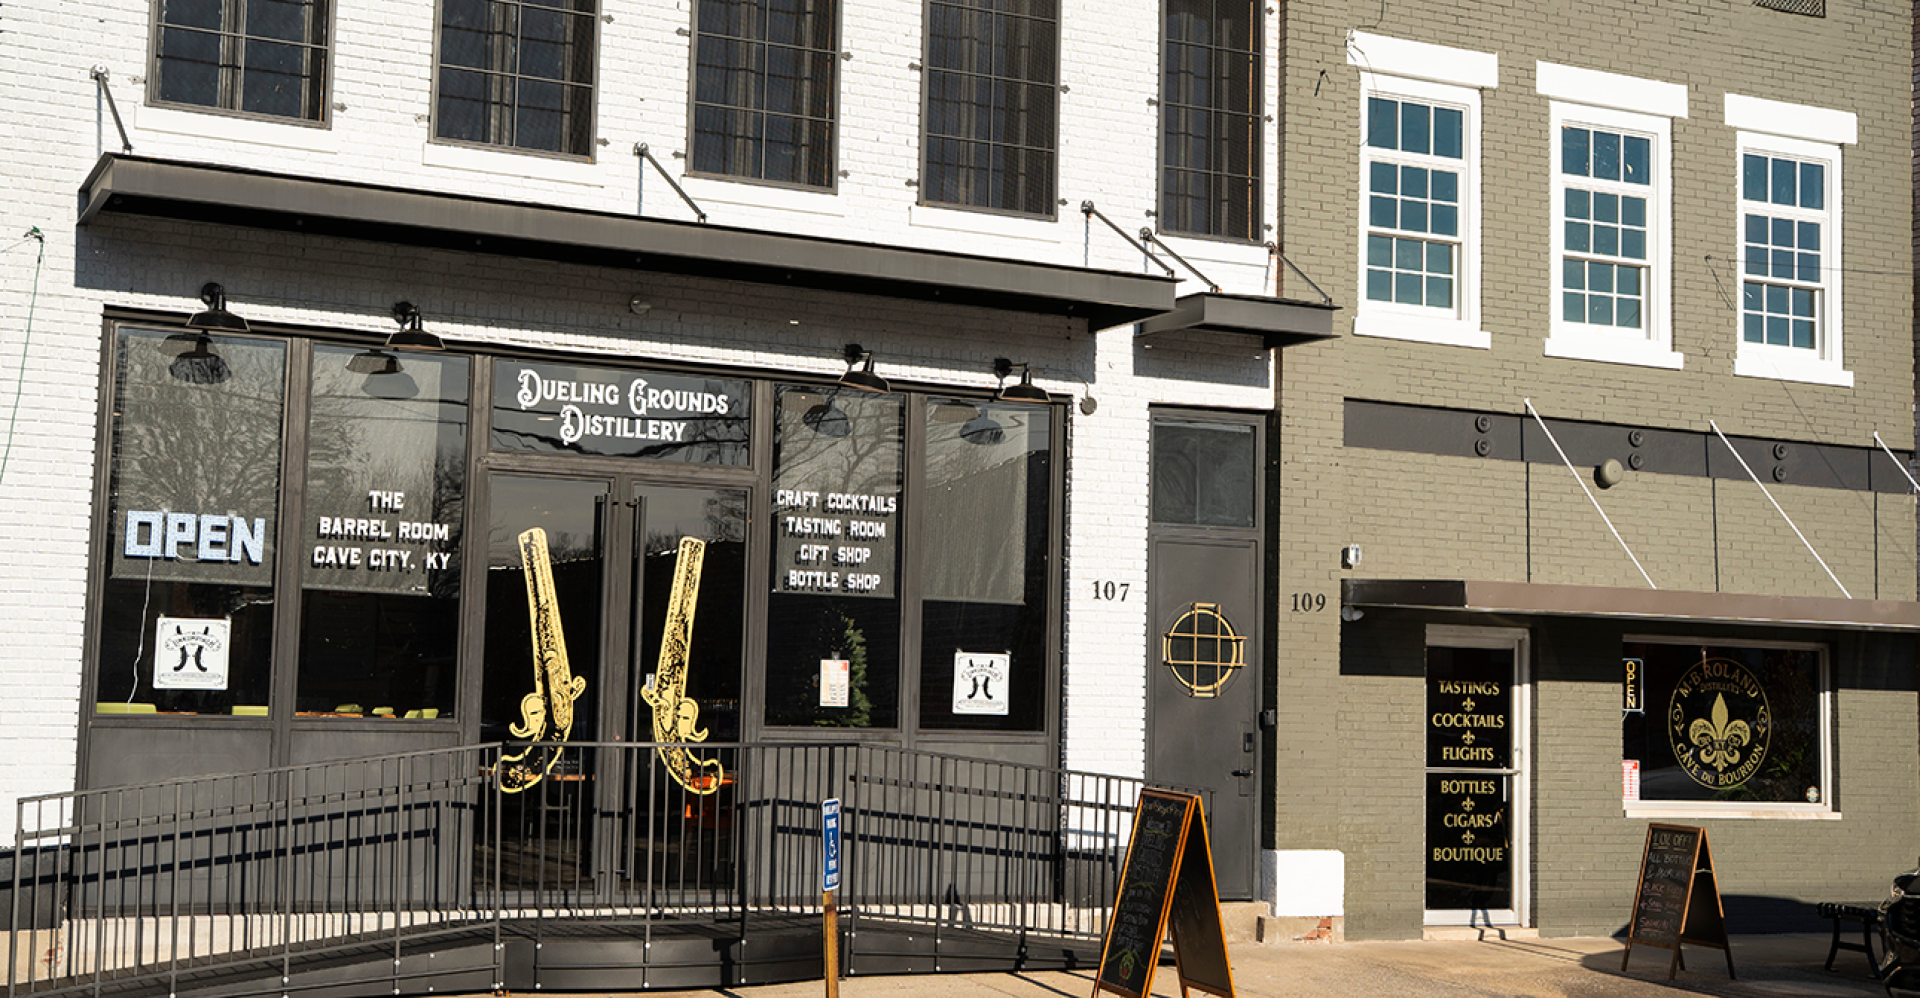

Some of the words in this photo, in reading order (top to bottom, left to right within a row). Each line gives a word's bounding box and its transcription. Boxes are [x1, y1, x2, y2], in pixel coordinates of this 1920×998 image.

[368, 490, 404, 509] THE
[777, 490, 819, 507] CRAFT
[828, 493, 897, 512] COCKTAILS
[124, 510, 266, 564] OPEN
[319, 516, 392, 537] BARREL
[398, 521, 449, 541] ROOM
[786, 517, 842, 536] TASTING
[850, 521, 887, 538] ROOM
[313, 546, 362, 565] CAVE
[426, 552, 452, 570] KY
[800, 544, 830, 561] GIFT
[838, 546, 872, 563] SHOP
[789, 569, 839, 588] BOTTLE
[848, 573, 881, 590] SHOP
[1092, 580, 1131, 602] 107
[1290, 592, 1327, 613] 109
[1438, 680, 1500, 696] TASTINGS
[1626, 660, 1637, 709] OPEN
[1432, 712, 1505, 729] COCKTAILS
[1442, 746, 1495, 761] FLIGHTS
[1676, 742, 1700, 776] CAVE
[1700, 770, 1716, 785] DU
[1718, 743, 1764, 786] BOURBON
[1441, 779, 1496, 795] BOTTLES
[1443, 812, 1494, 828] CIGARS
[1432, 846, 1504, 864] BOUTIQUE
